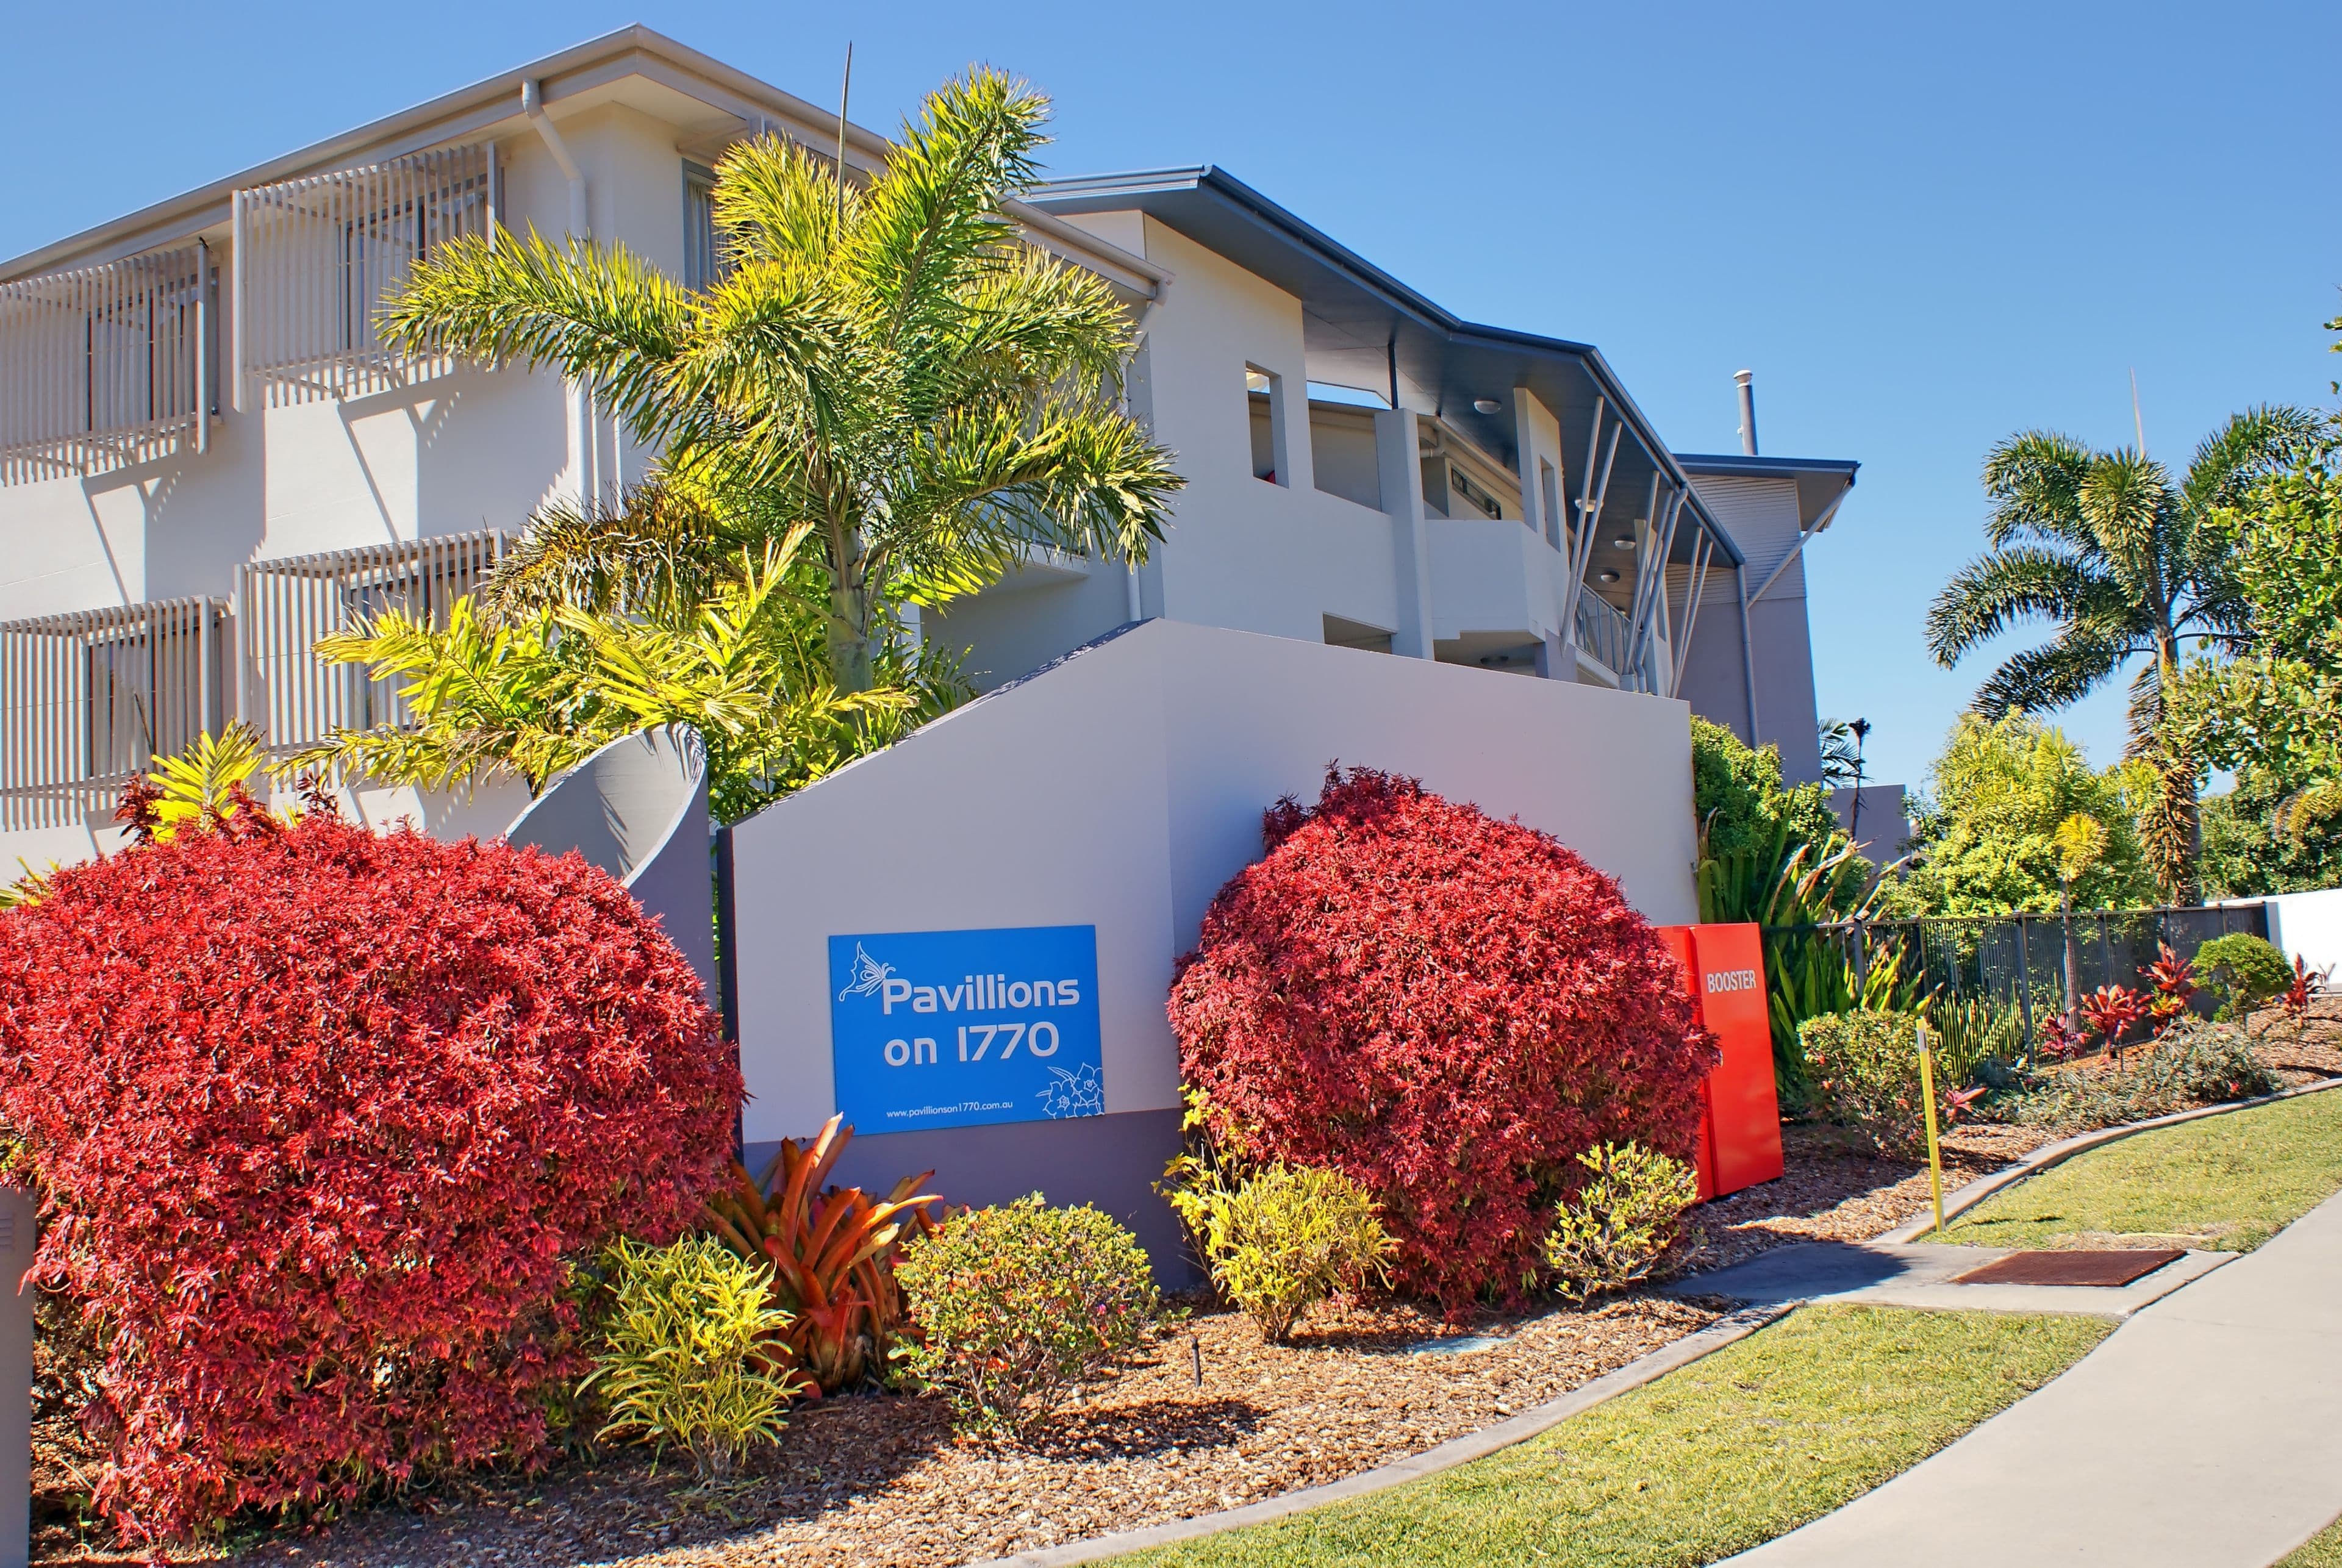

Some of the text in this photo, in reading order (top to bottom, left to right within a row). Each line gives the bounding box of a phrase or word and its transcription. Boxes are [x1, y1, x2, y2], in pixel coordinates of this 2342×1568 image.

[883, 974, 1080, 1015] Pavillions
[1706, 969, 1756, 993] BOOSTER
[884, 1021, 1060, 1066] on 1770
[886, 1101, 1014, 1118] www.pavillionson1770.com.au
